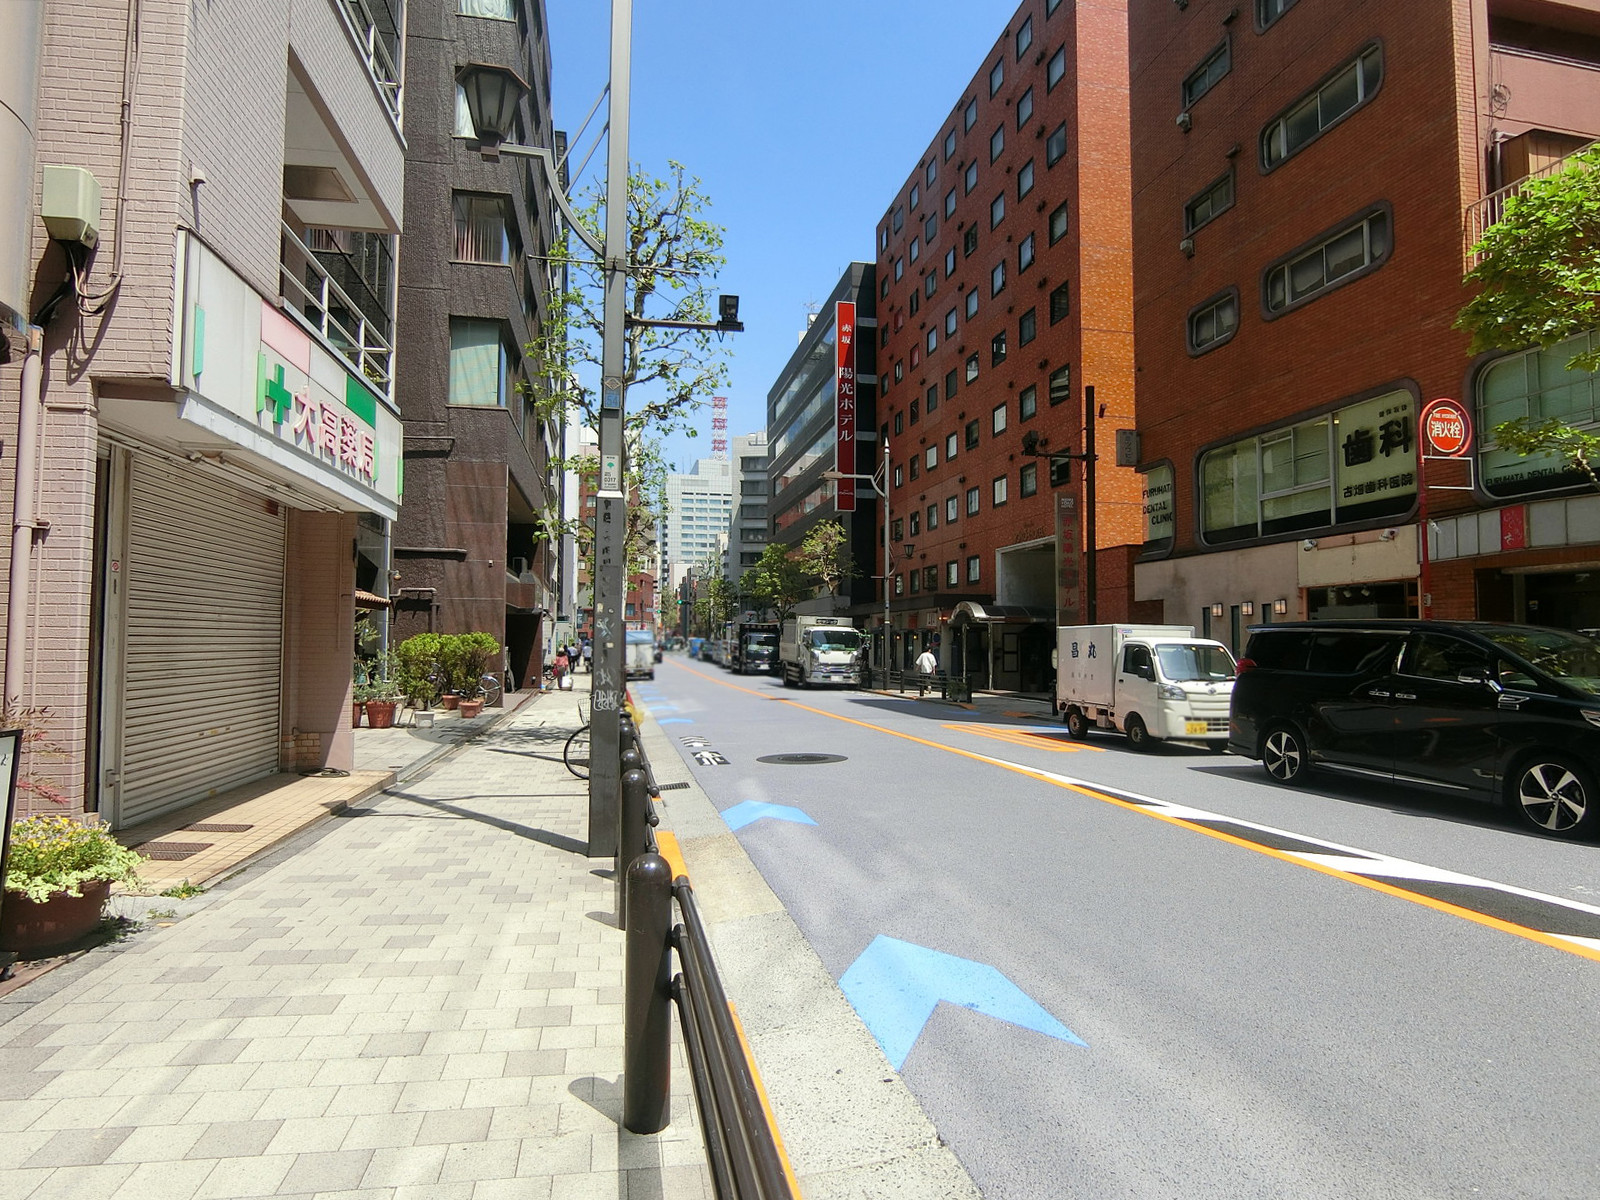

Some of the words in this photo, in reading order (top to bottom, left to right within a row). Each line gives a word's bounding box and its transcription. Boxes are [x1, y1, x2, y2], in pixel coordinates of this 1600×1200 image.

[841, 323, 852, 345] 赤坂
[838, 366, 854, 442] 陽光ホテル
[294, 384, 375, 479] 大高薬局
[1342, 416, 1410, 467] 歯科
[1431, 420, 1461, 439] 消火栓
[1343, 473, 1413, 498] 古畑歯科医院
[1142, 501, 1167, 515] DENTAL
